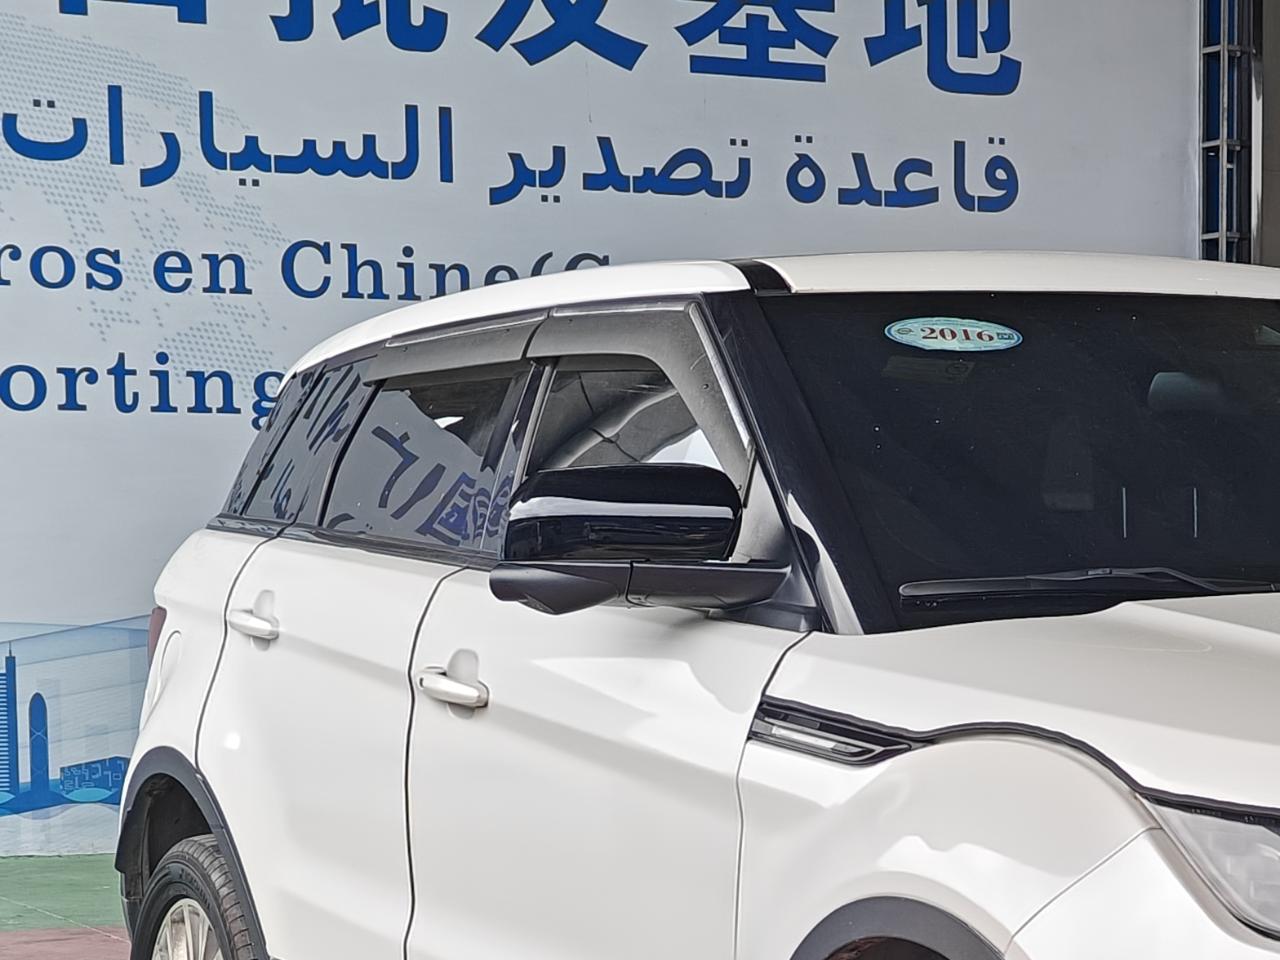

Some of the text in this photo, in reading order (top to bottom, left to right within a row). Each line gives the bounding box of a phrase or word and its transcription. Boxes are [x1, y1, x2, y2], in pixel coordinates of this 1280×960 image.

[2, 85, 1020, 213] قاعدة تصدير السيارات
[152, 247, 253, 295] en
[920, 326, 995, 343] 2016
